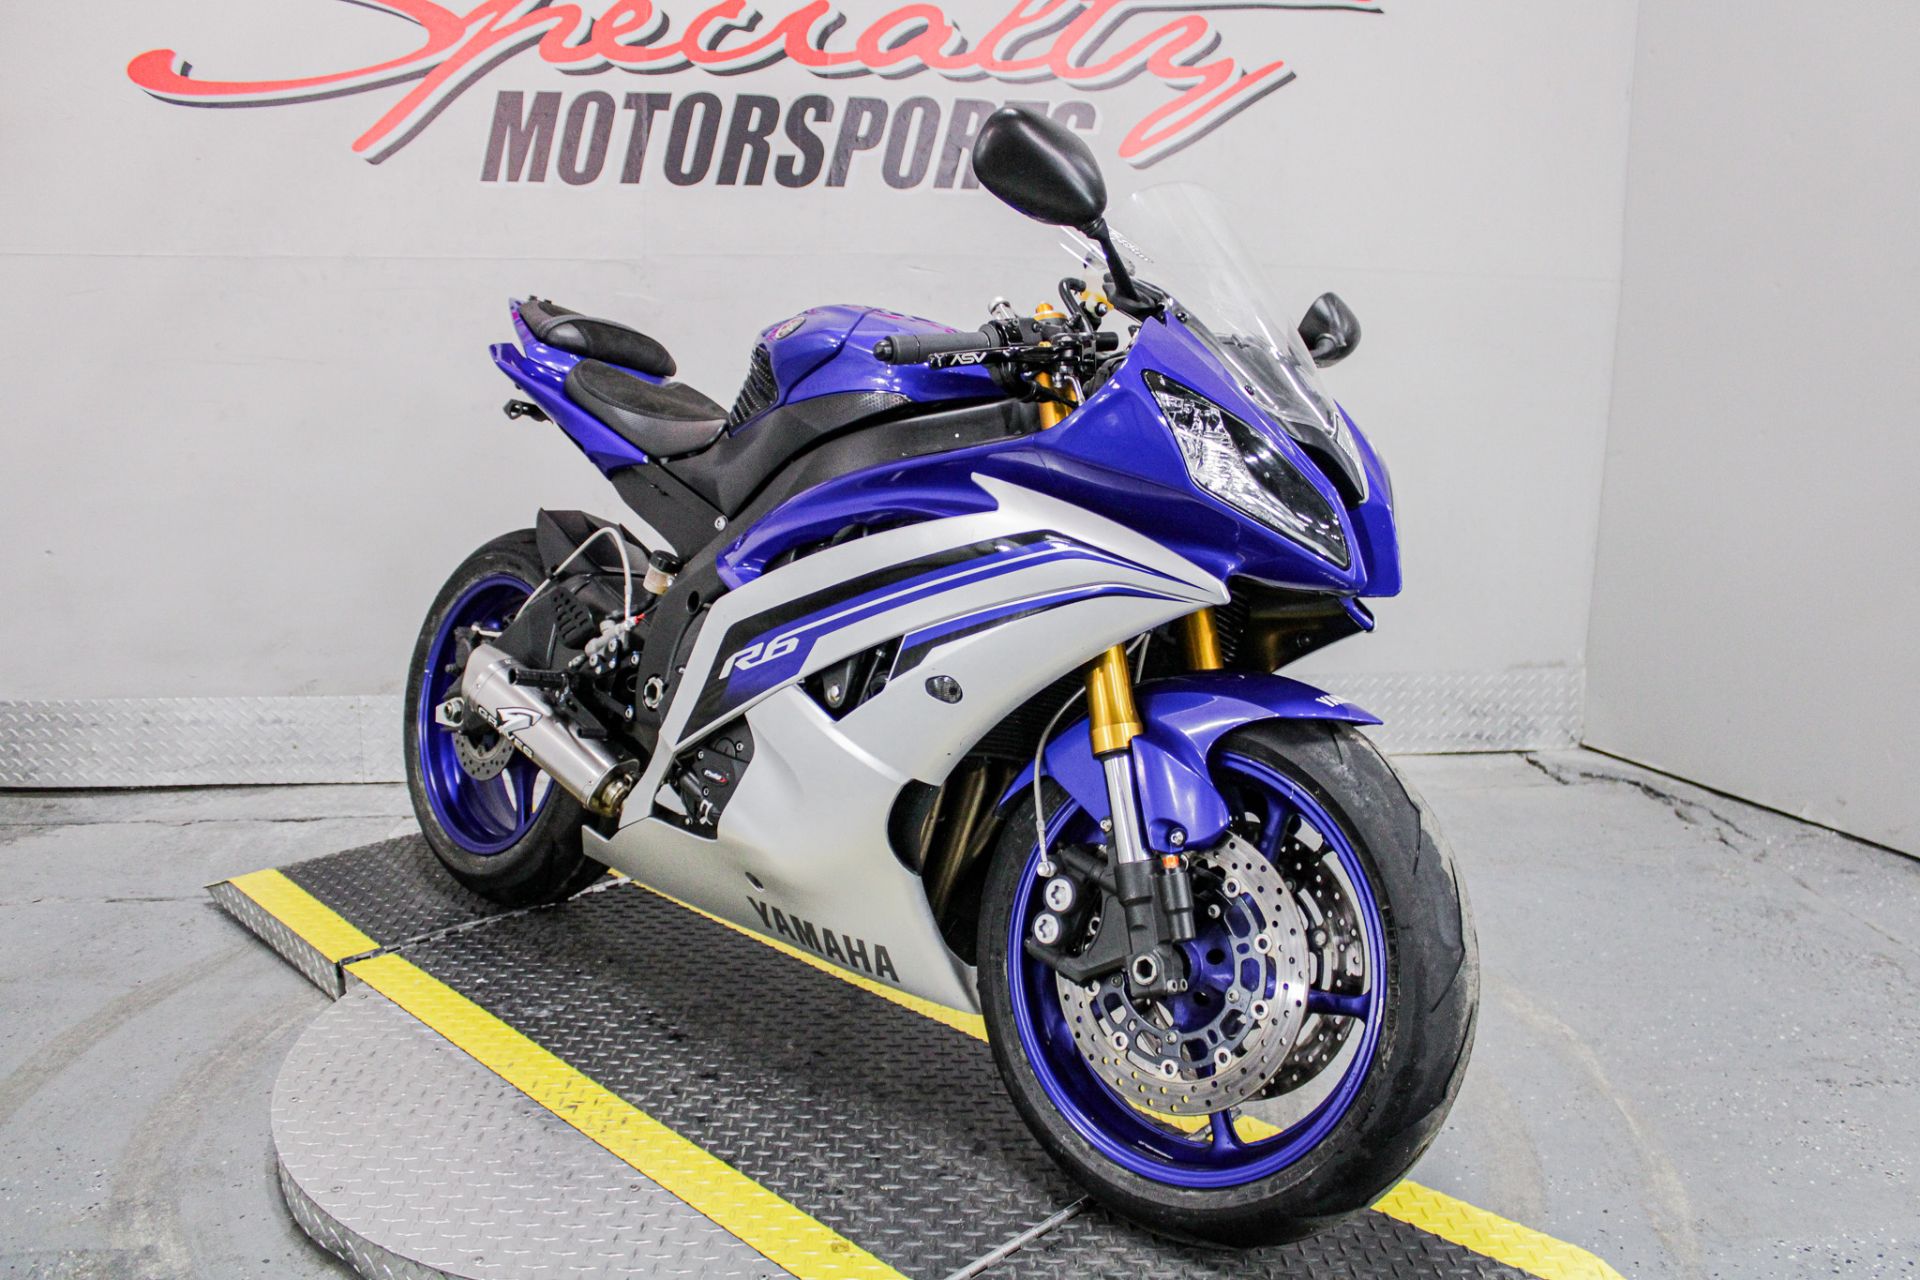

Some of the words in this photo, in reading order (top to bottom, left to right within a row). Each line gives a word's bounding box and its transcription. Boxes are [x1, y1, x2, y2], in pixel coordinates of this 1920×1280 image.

[480, 89, 1097, 190] MOTORSPOR
[950, 351, 987, 366] ASV
[718, 637, 799, 680] R6
[746, 895, 900, 983] YAMAHA
